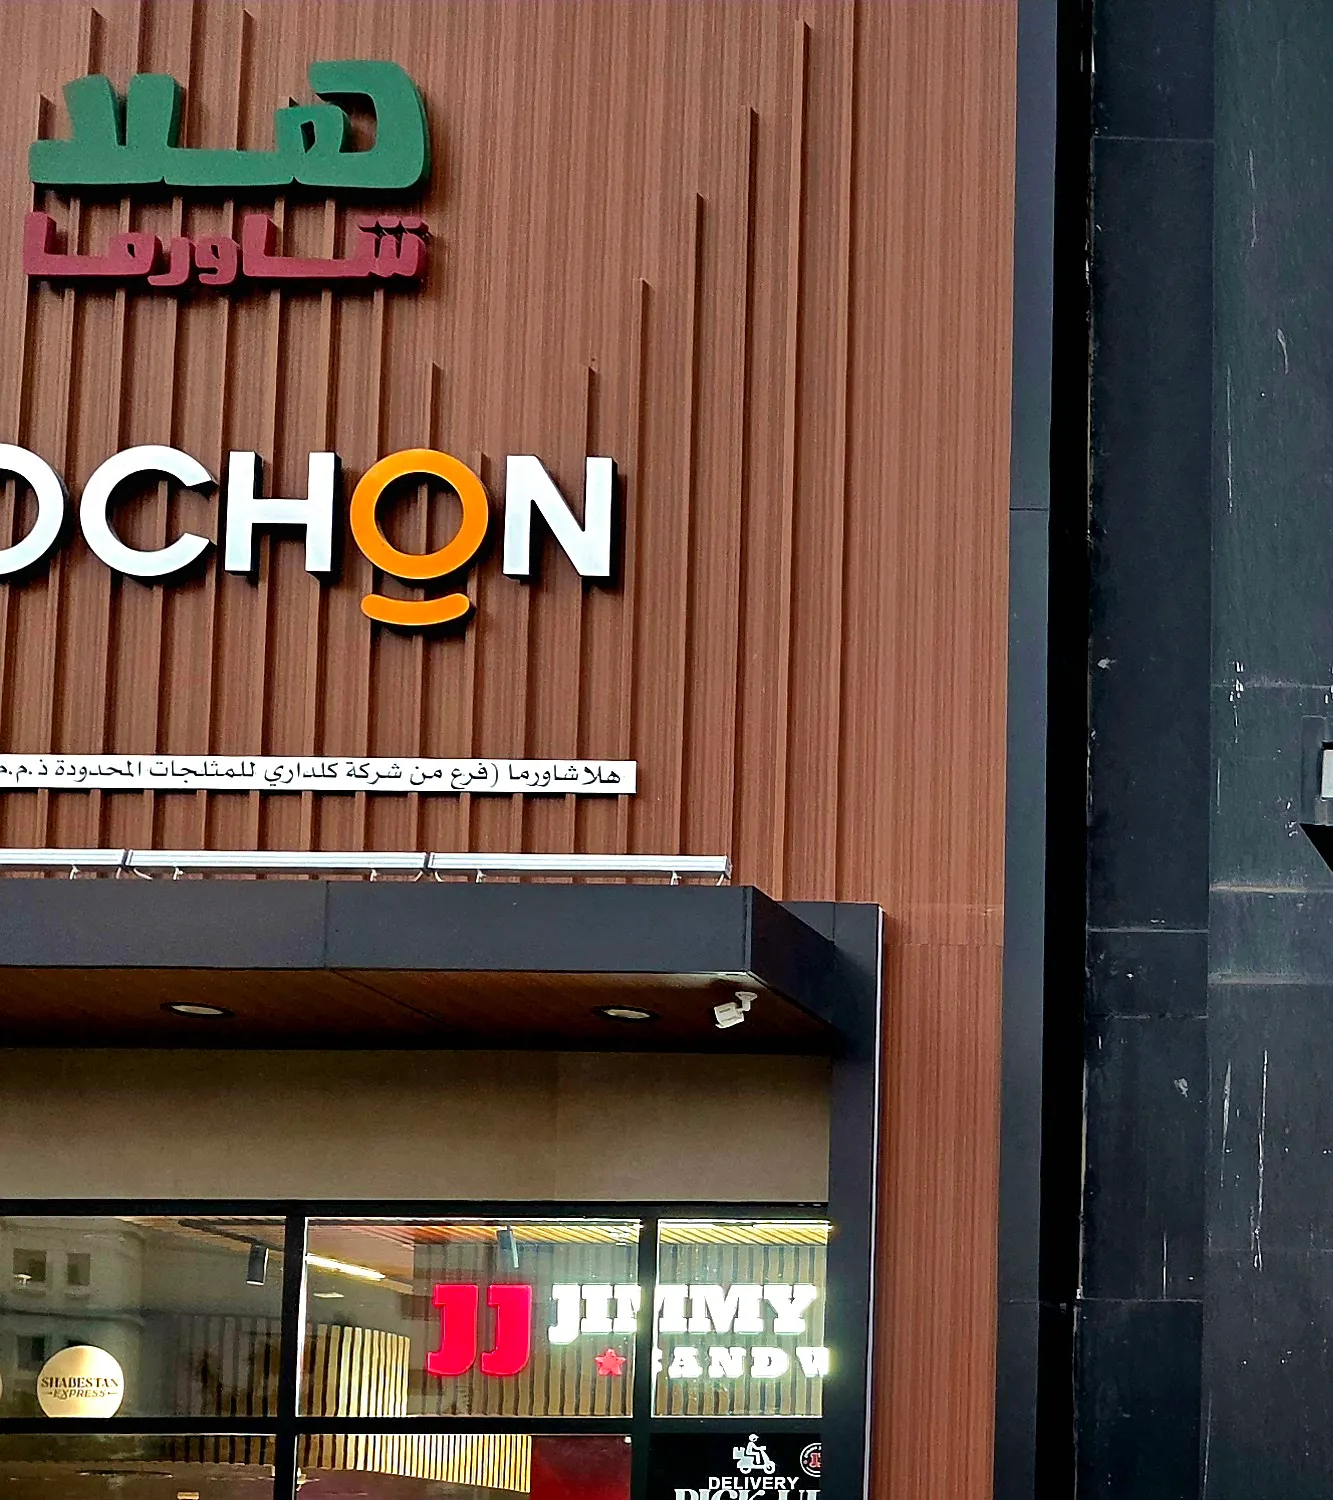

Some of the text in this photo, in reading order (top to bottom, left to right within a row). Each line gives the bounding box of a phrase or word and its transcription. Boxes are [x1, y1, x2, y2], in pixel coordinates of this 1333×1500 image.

[29, 59, 431, 190] هلا
[23, 212, 431, 288] شاورما
[54, 759, 142, 783] المحدودة
[346, 760, 402, 785] شركة
[410, 763, 443, 786] من
[509, 763, 578, 788] شاورما
[547, 1284, 817, 1345] JIMMY
[427, 1284, 532, 1377] JJ
[652, 1346, 830, 1378] ANDW
[41, 1377, 119, 1389] SHABESTAN
[53, 1388, 106, 1400] EXPRESS
[708, 1476, 800, 1491] DELIVERY
